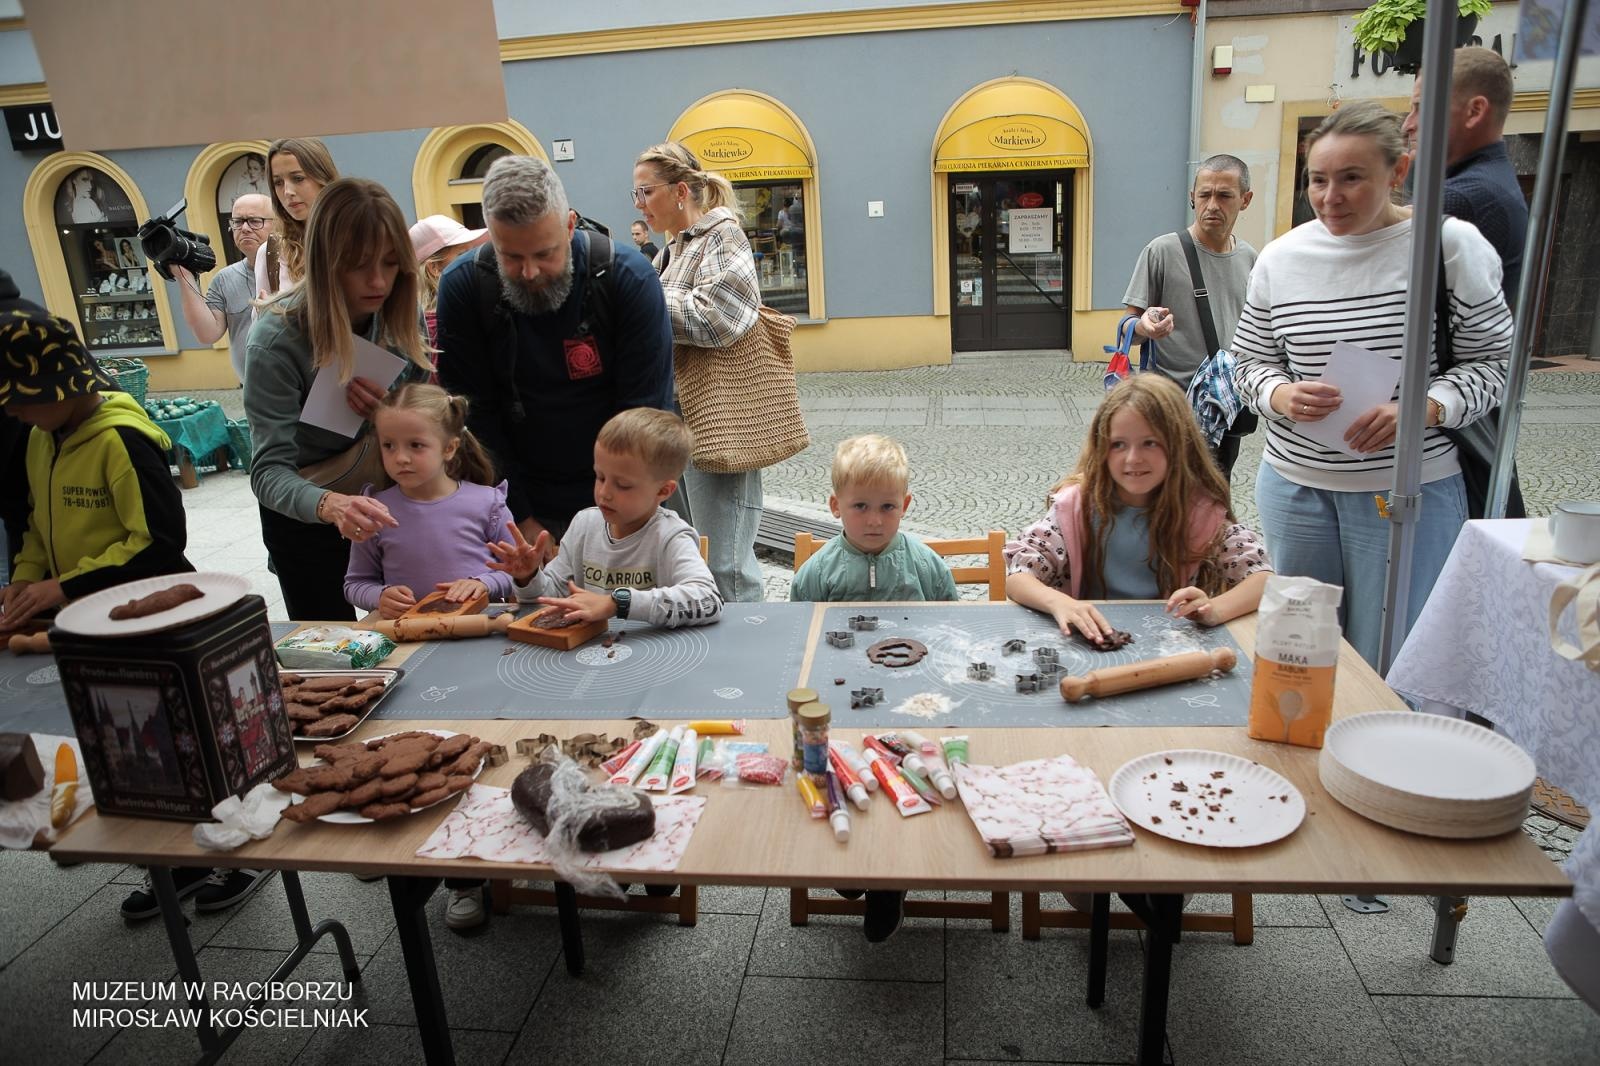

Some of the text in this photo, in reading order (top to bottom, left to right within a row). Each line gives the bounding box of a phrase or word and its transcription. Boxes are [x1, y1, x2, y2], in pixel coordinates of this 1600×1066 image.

[994, 135, 1041, 146] Markiewka
[560, 142, 567, 153] 4
[703, 148, 748, 159] Markiewka
[1015, 159, 1053, 168] CUKIERNIA
[62, 486, 84, 496] SUPER
